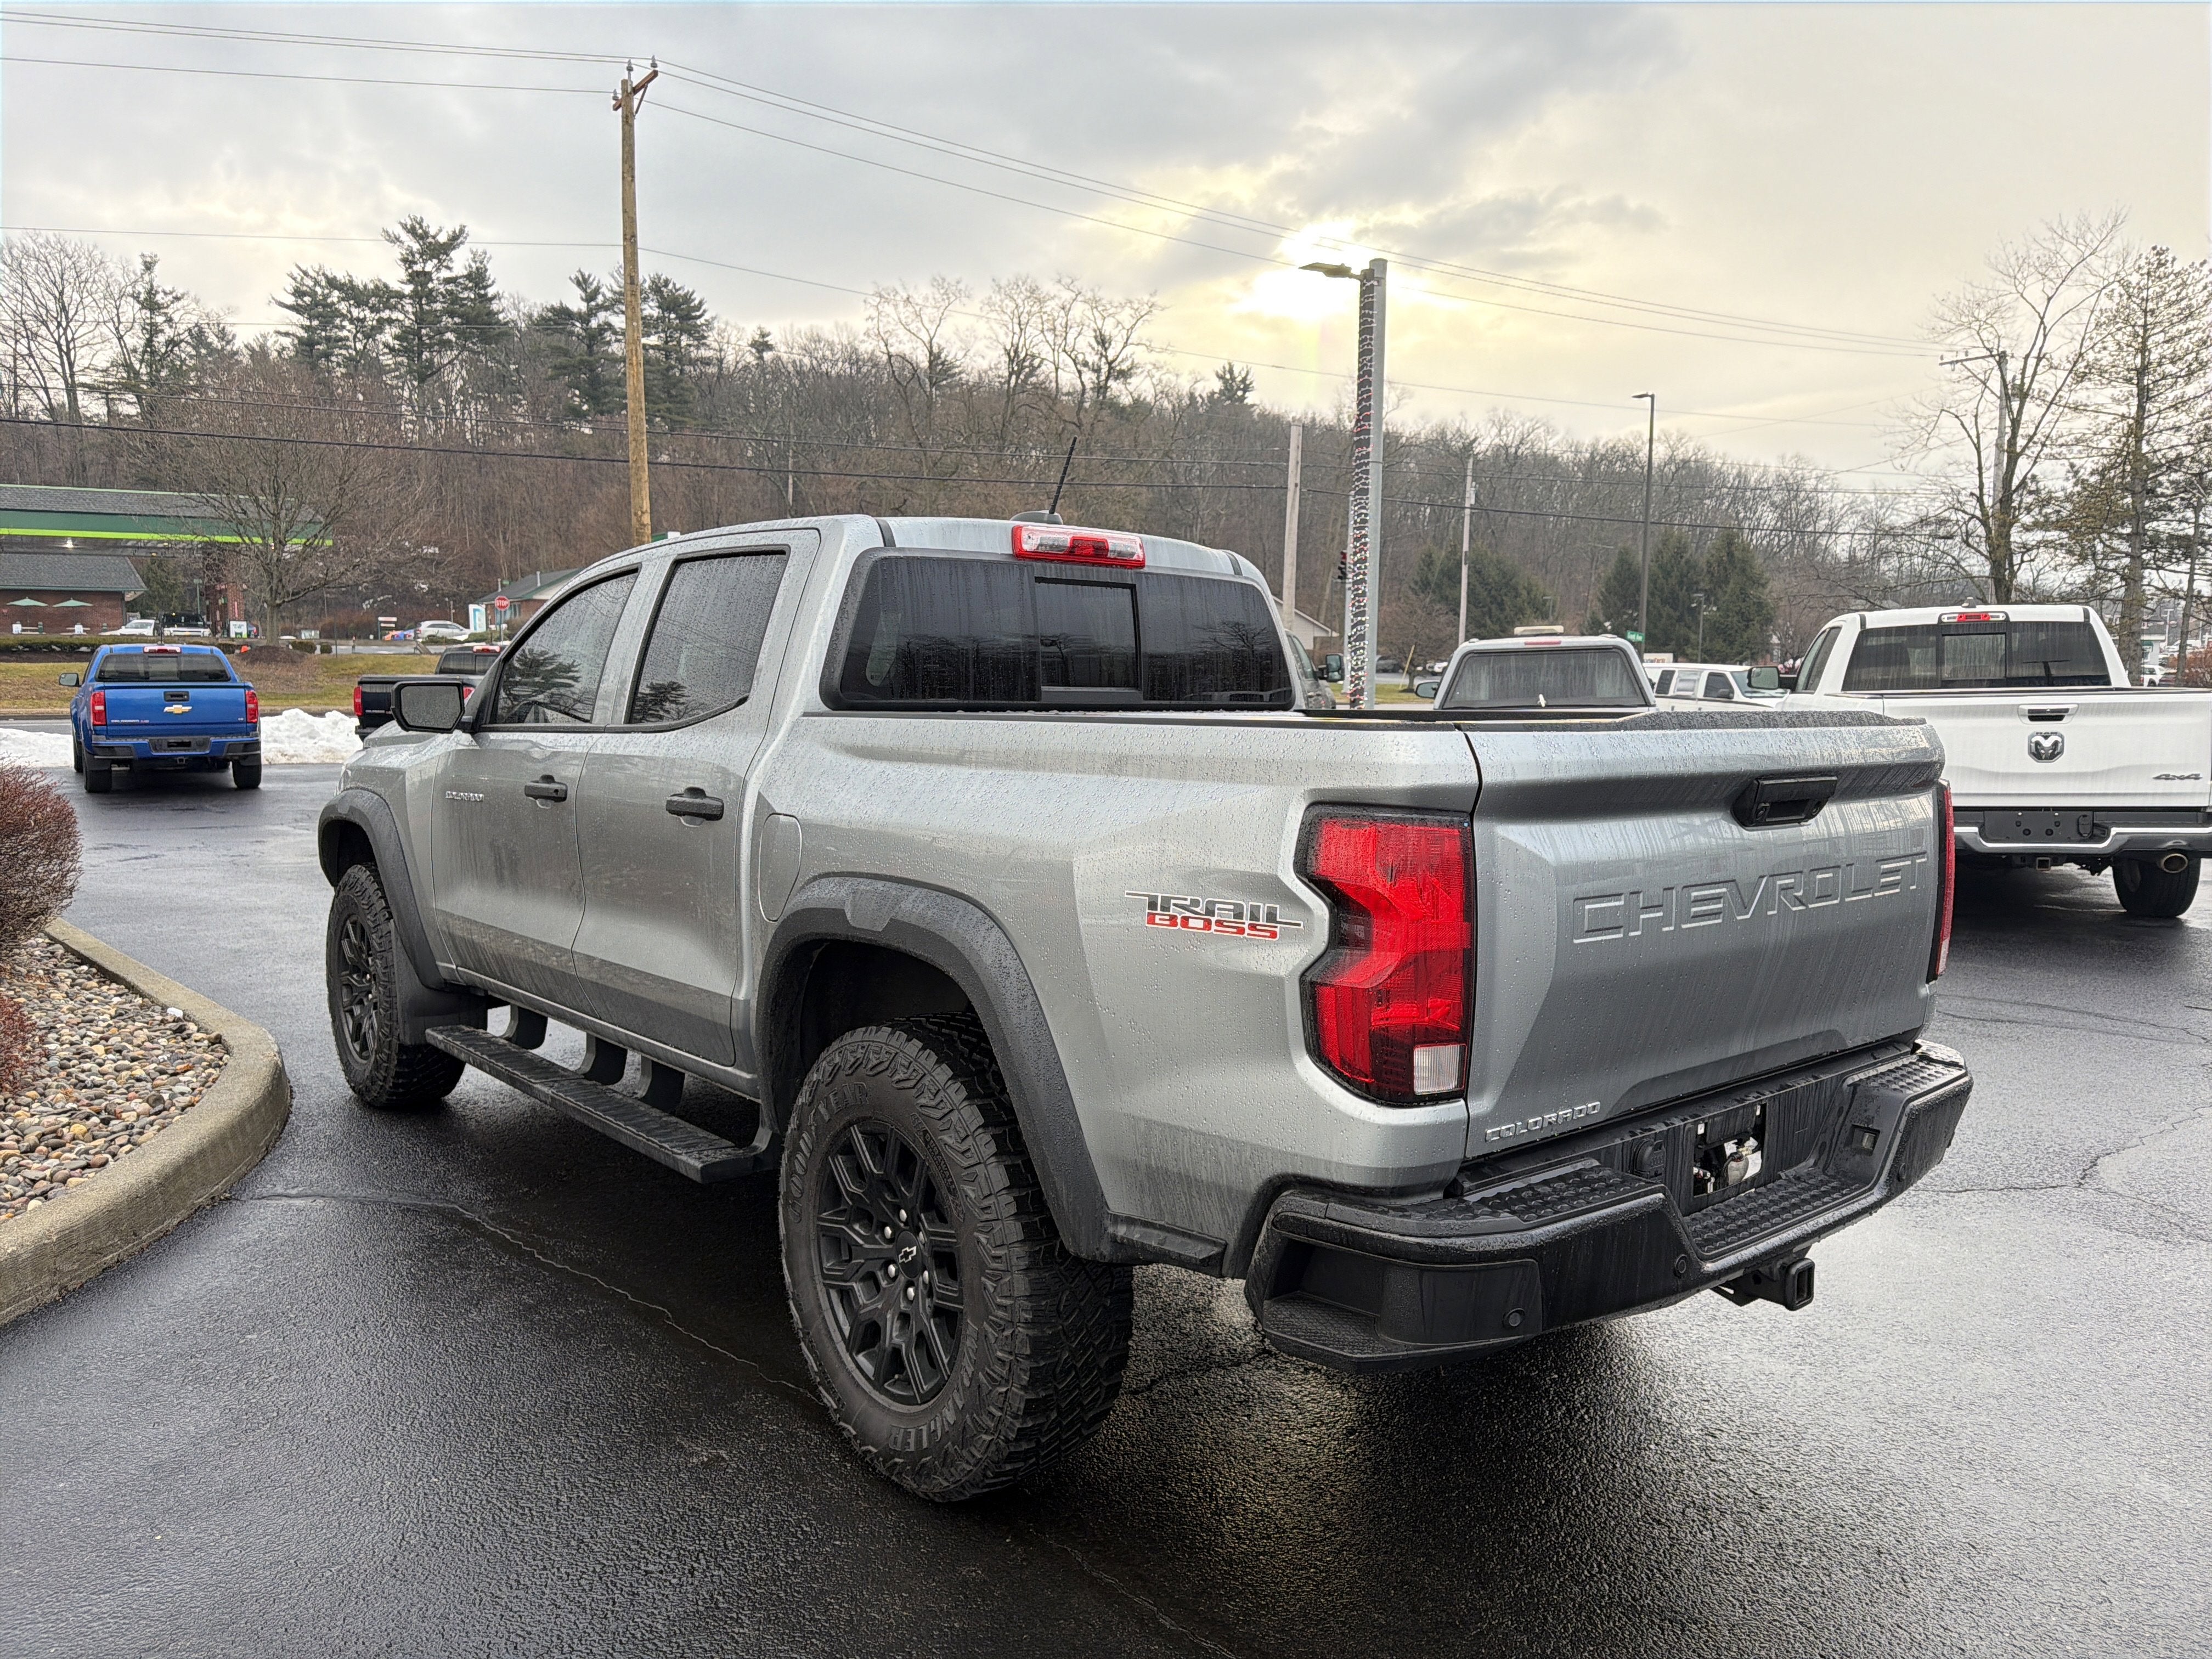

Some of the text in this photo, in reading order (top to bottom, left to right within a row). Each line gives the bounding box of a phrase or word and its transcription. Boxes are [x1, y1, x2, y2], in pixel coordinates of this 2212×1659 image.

[1125, 890, 1303, 929] TRAIL
[1573, 852, 1927, 944] CHEVROLET
[1146, 911, 1279, 941] BOSS
[1485, 1101, 1601, 1143] COLORADO
